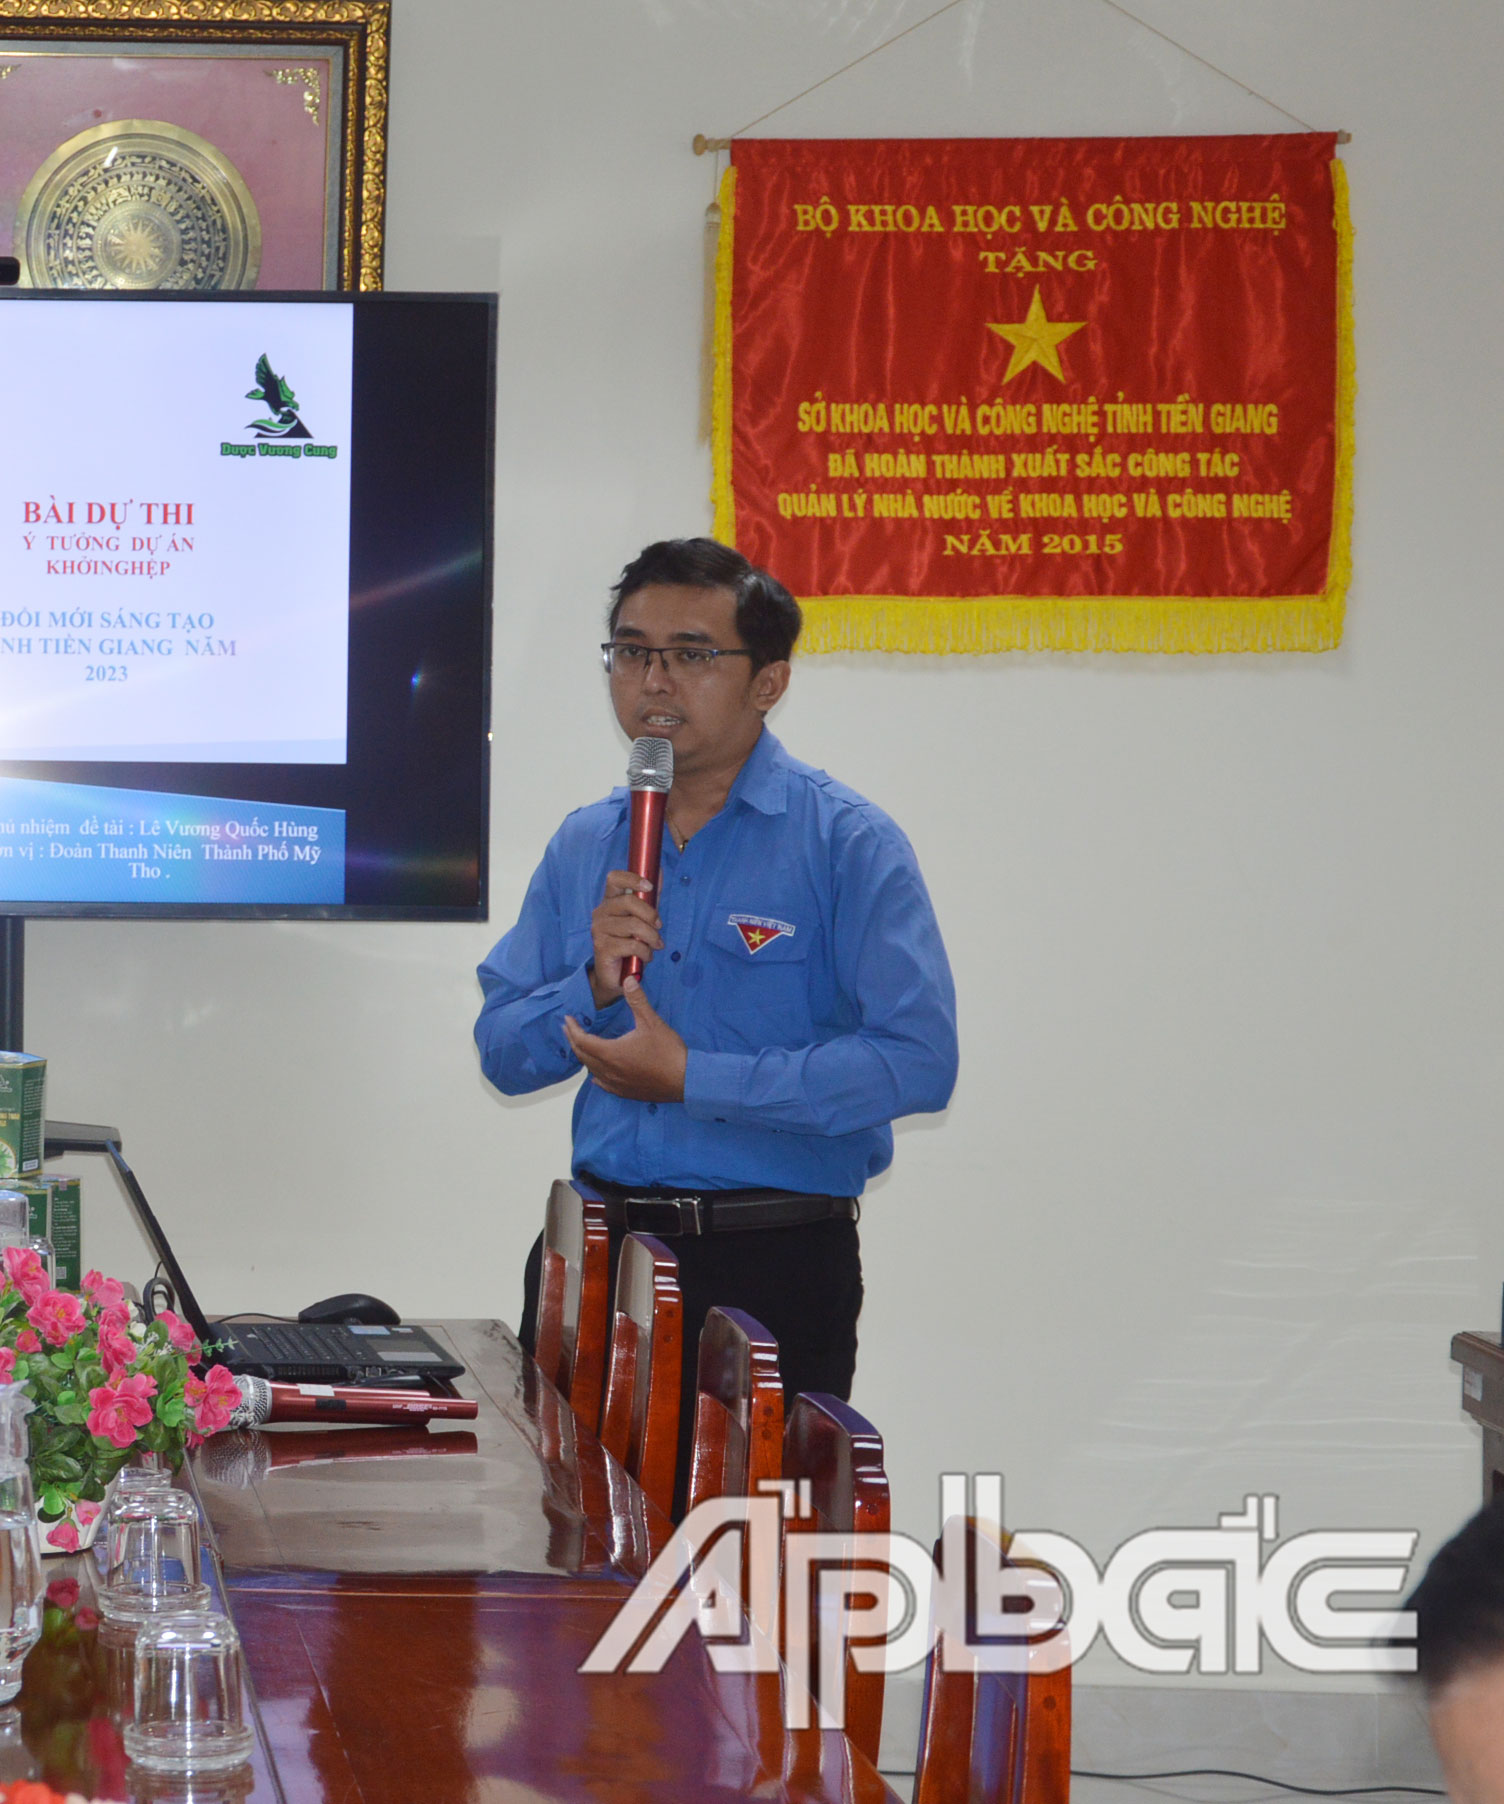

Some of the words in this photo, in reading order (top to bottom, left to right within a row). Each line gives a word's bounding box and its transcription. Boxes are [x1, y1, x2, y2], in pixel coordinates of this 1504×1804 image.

[795, 196, 838, 237] BỘ
[848, 205, 944, 231] KHOA
[953, 206, 1020, 239] HỌC
[1032, 198, 1077, 231] VÀ
[1087, 196, 1179, 230] CÔNG
[1191, 194, 1285, 234] NGHỆ
[980, 248, 1096, 277] TẶNG
[798, 392, 826, 432] SỞ
[831, 403, 889, 432] KHOA
[895, 404, 937, 441] HỌC
[943, 397, 971, 434] VÀ
[977, 398, 1037, 435] CÔNG
[1043, 396, 1098, 442] NGHỆ
[1104, 392, 1152, 432] TỈNH
[1157, 394, 1203, 433] TIỀN
[1211, 404, 1277, 434] GIANG
[304, 444, 337, 458] Cung
[829, 449, 859, 477] ĐÃ
[865, 449, 926, 477] HOÀN
[932, 450, 1005, 478] THÀNH
[1012, 445, 1070, 477] XUẤT
[1076, 446, 1121, 477] SẮC
[1128, 449, 1190, 477] CÔNG
[1197, 449, 1239, 476] TÁC
[22, 495, 75, 524] BÀI
[86, 499, 134, 530] DỰ
[140, 502, 194, 525] THI
[778, 484, 837, 519] QUẢN
[842, 489, 867, 517] LÝ
[874, 490, 919, 518] NHÀ
[923, 489, 981, 519] NƯỚC
[987, 488, 1014, 518] VỀ
[1020, 494, 1077, 517] KHOA
[1083, 494, 1127, 522] HỌC
[1133, 489, 1161, 517] VÀ
[1168, 489, 1226, 517] CÔNG
[1233, 490, 1291, 523] NGHỆ
[22, 532, 36, 550] Ý
[47, 534, 121, 551] TƯỞNG
[131, 535, 162, 555] DỰ
[167, 533, 195, 552] ÁN
[944, 530, 1032, 555] NĂM
[1043, 534, 1123, 554] 2015
[48, 608, 93, 629] MỚI
[100, 607, 161, 630] SÁNG
[167, 613, 215, 633] TẠO
[39, 635, 92, 654] TIỀN
[99, 638, 173, 656] GIANG
[185, 637, 237, 656] NĂM
[84, 665, 129, 682] 2023
[20, 819, 70, 837] nhiệm
[80, 816, 99, 835] đề
[104, 820, 123, 835] tài
[140, 820, 160, 836] Lê
[166, 820, 221, 839] Vương
[225, 817, 269, 839] Quốc
[274, 821, 319, 841] Hùng
[19, 843, 34, 860] vị
[50, 843, 92, 858] Đoàn
[98, 843, 148, 859] Thanh
[153, 844, 191, 859] Niên
[202, 844, 252, 860] Thành
[258, 841, 288, 861] Phố
[294, 845, 321, 864] Mỹ
